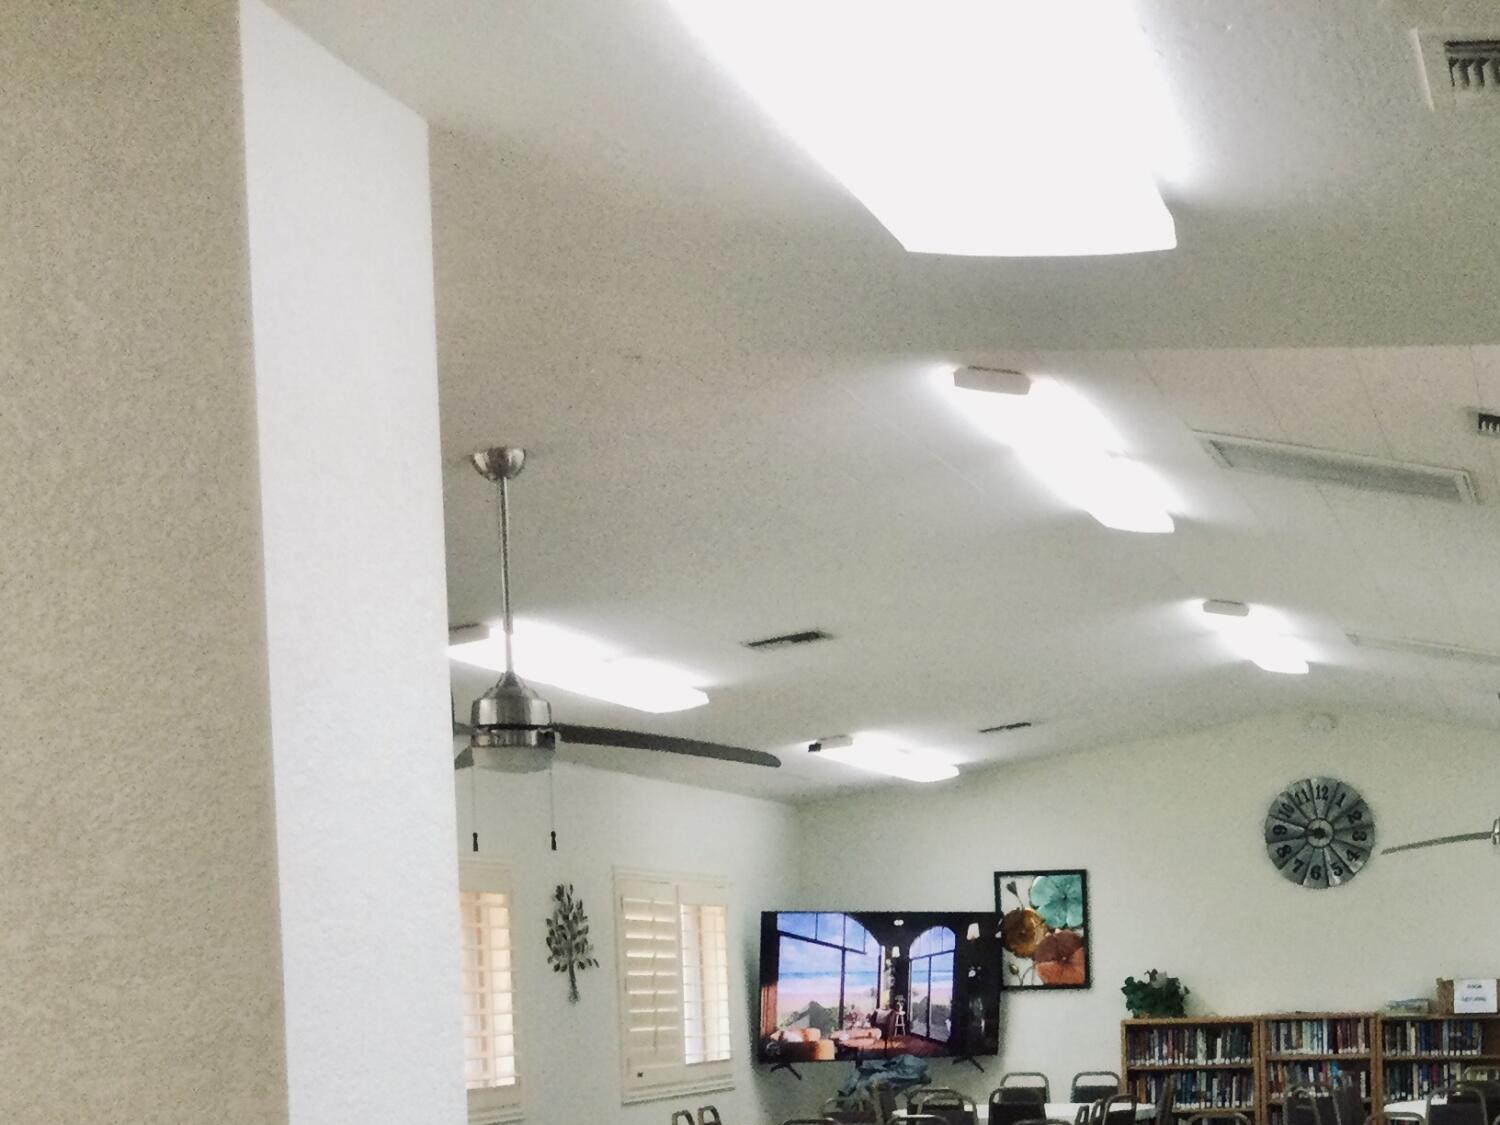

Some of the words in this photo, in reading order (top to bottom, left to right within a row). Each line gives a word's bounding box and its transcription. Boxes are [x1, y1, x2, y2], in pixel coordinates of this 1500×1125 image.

[1295, 789, 1311, 805] 11
[1316, 784, 1328, 800] 12
[1336, 792, 1346, 807] 1
[1278, 803, 1295, 819] 10
[1347, 810, 1362, 824] 2
[1272, 824, 1288, 836] 9
[1351, 830, 1367, 841] 3
[1276, 844, 1292, 858] 8
[1346, 849, 1361, 862] 4
[1293, 859, 1304, 873] 7
[1310, 865, 1322, 880] 6
[1331, 862, 1344, 876] 5
